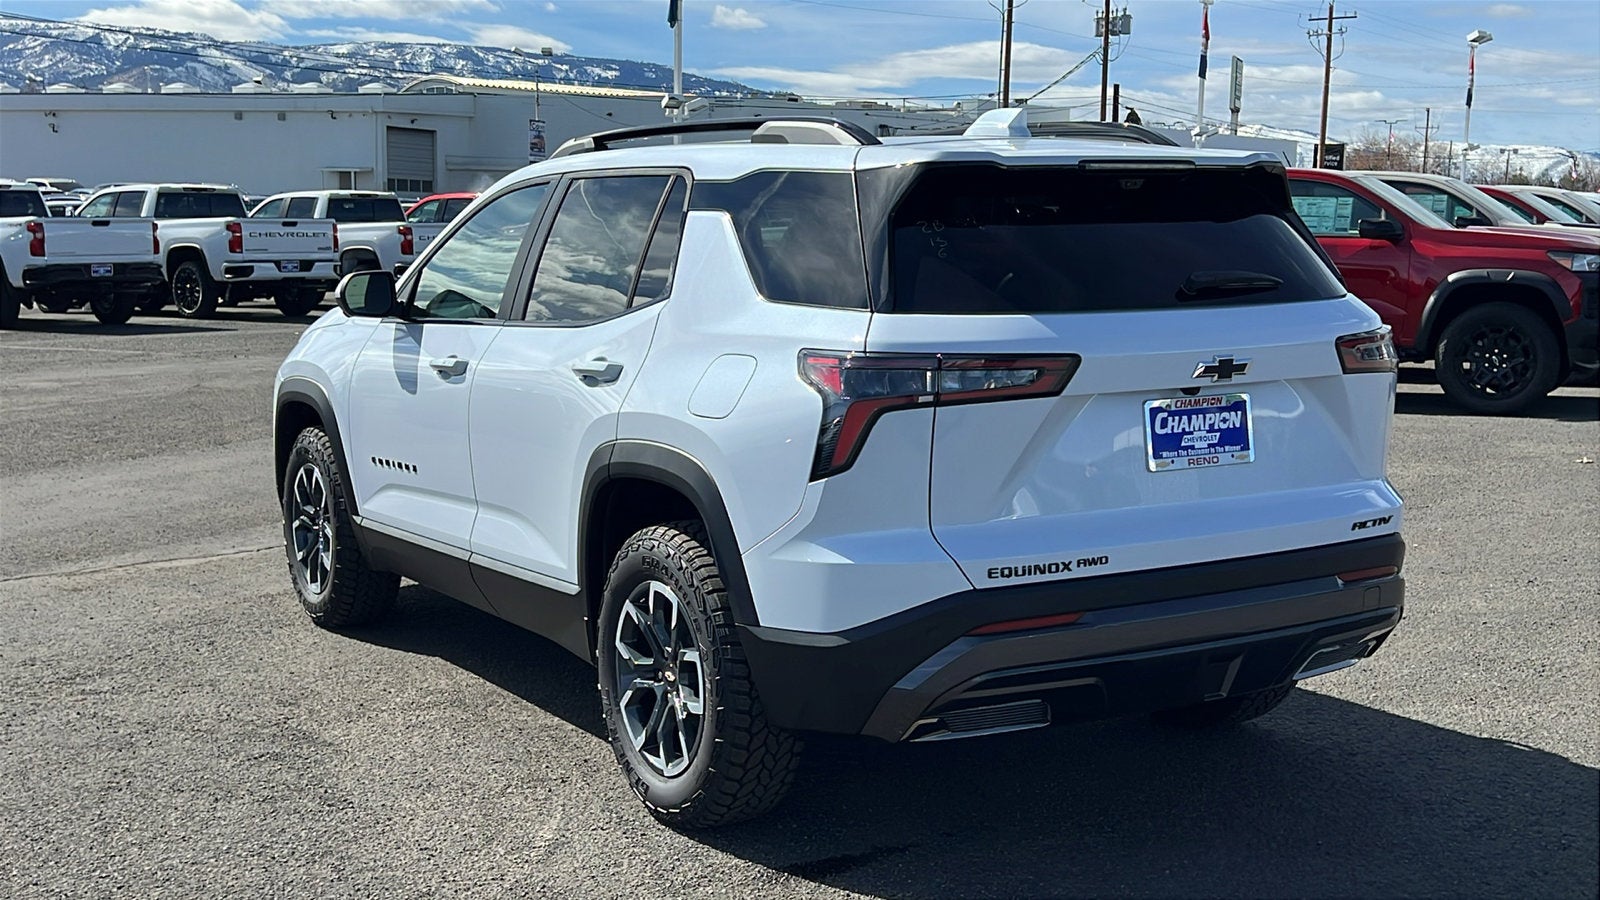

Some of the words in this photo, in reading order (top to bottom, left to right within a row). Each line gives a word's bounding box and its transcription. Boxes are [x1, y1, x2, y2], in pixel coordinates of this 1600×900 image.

[1174, 397, 1223, 408] CHAMPION
[1154, 411, 1242, 434] CHAMPION
[1183, 434, 1218, 444] CHEVROLET
[1187, 456, 1220, 467] RENO
[987, 560, 1073, 579] EQUINOX
[1076, 556, 1109, 568] AWD
